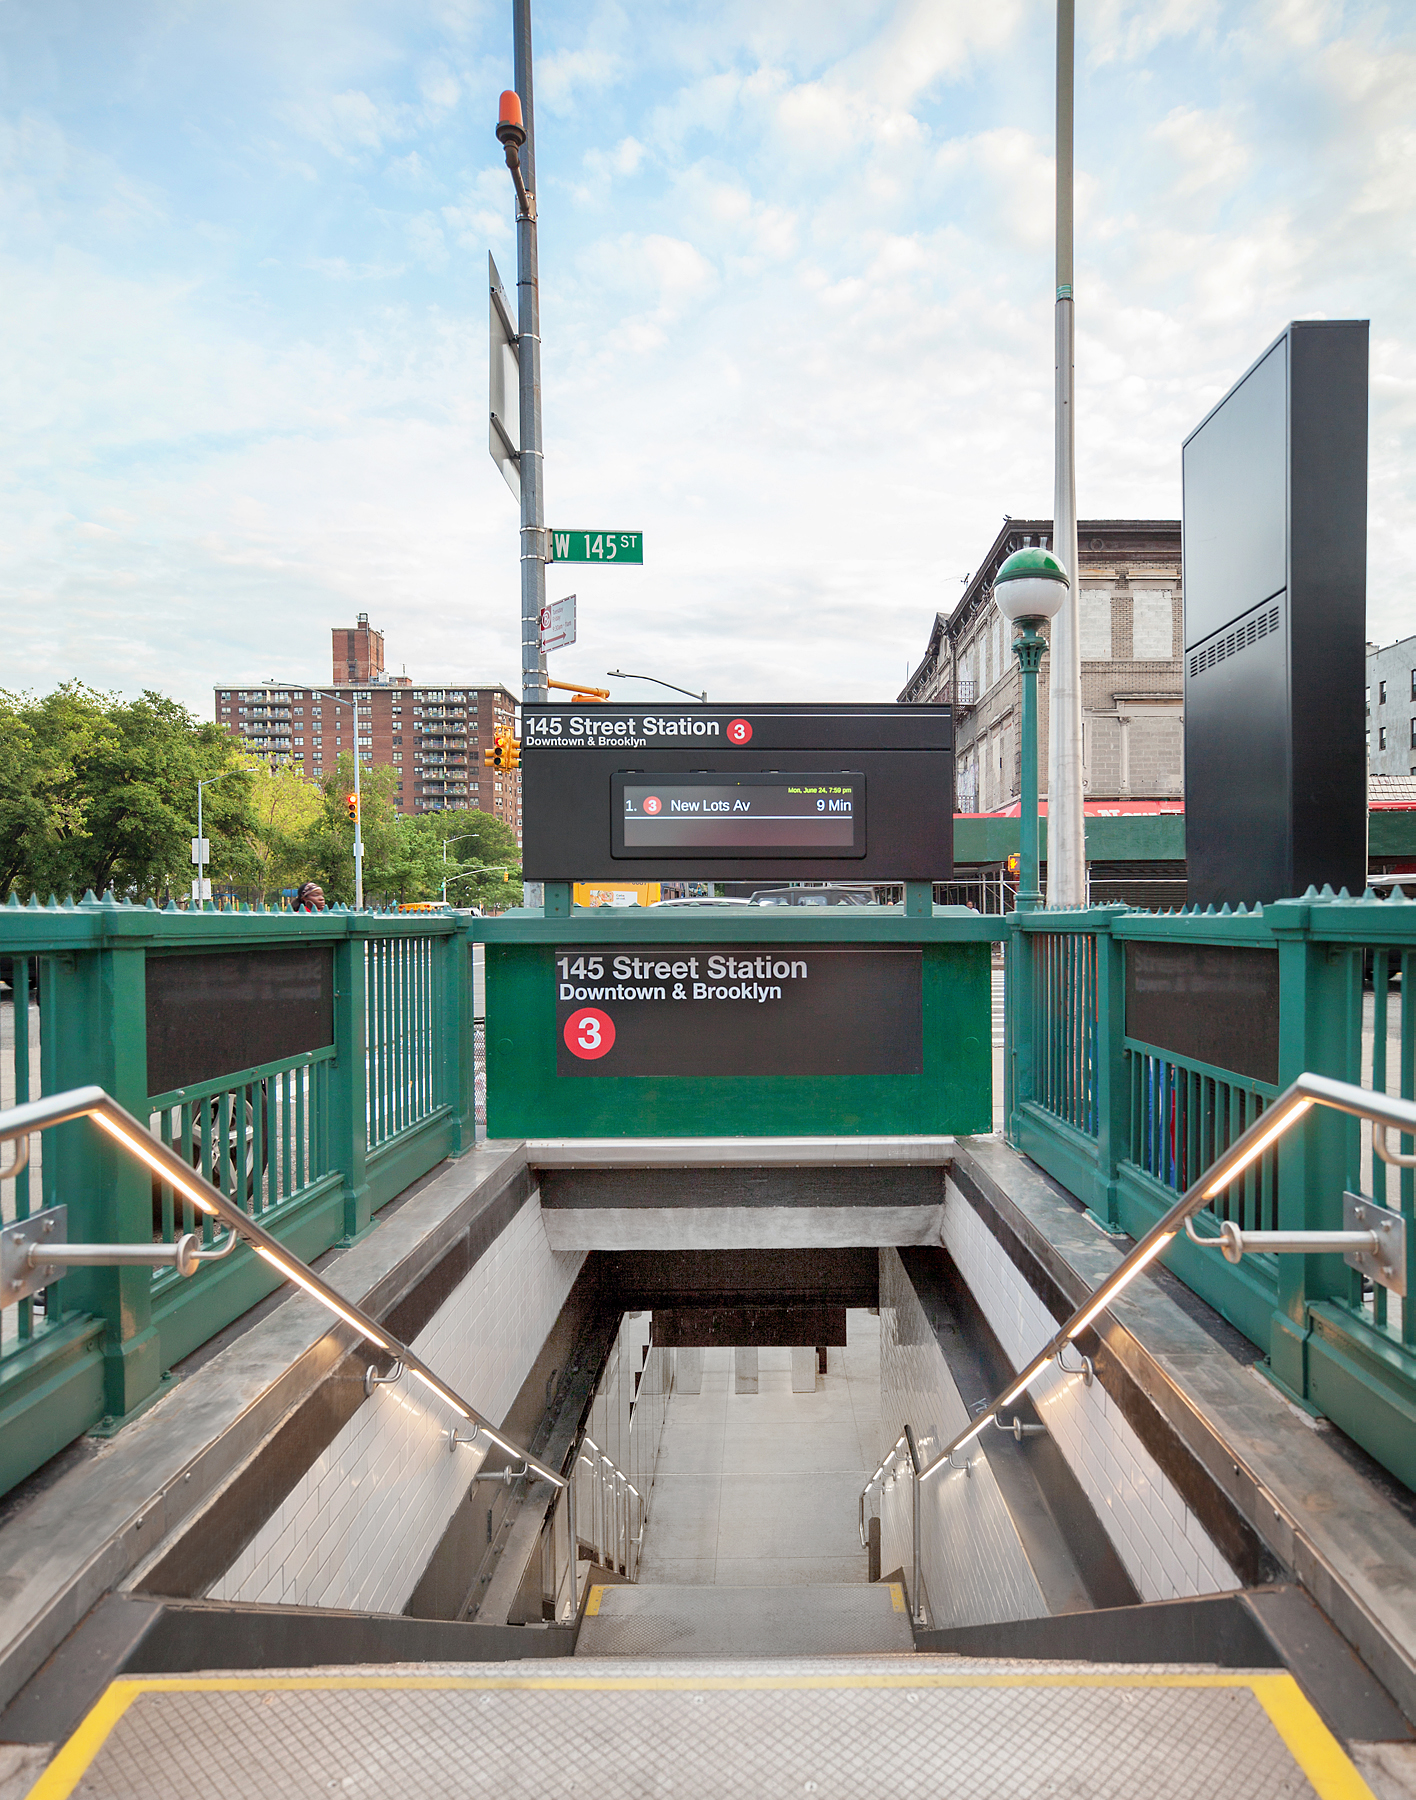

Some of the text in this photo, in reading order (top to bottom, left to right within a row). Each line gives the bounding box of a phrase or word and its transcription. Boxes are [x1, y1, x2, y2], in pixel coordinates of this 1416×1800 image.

[554, 534, 638, 559] W 145 ST
[526, 717, 720, 736] 145 Street Station
[733, 724, 746, 740] 3
[526, 736, 647, 749] Downtown & Brooklyn
[625, 799, 852, 812] 1. 3 New Lots Av 9 Min
[557, 956, 808, 980] 145 Street Station
[559, 982, 782, 1003] Downtown & Brooklyn
[577, 1016, 602, 1050] 3
